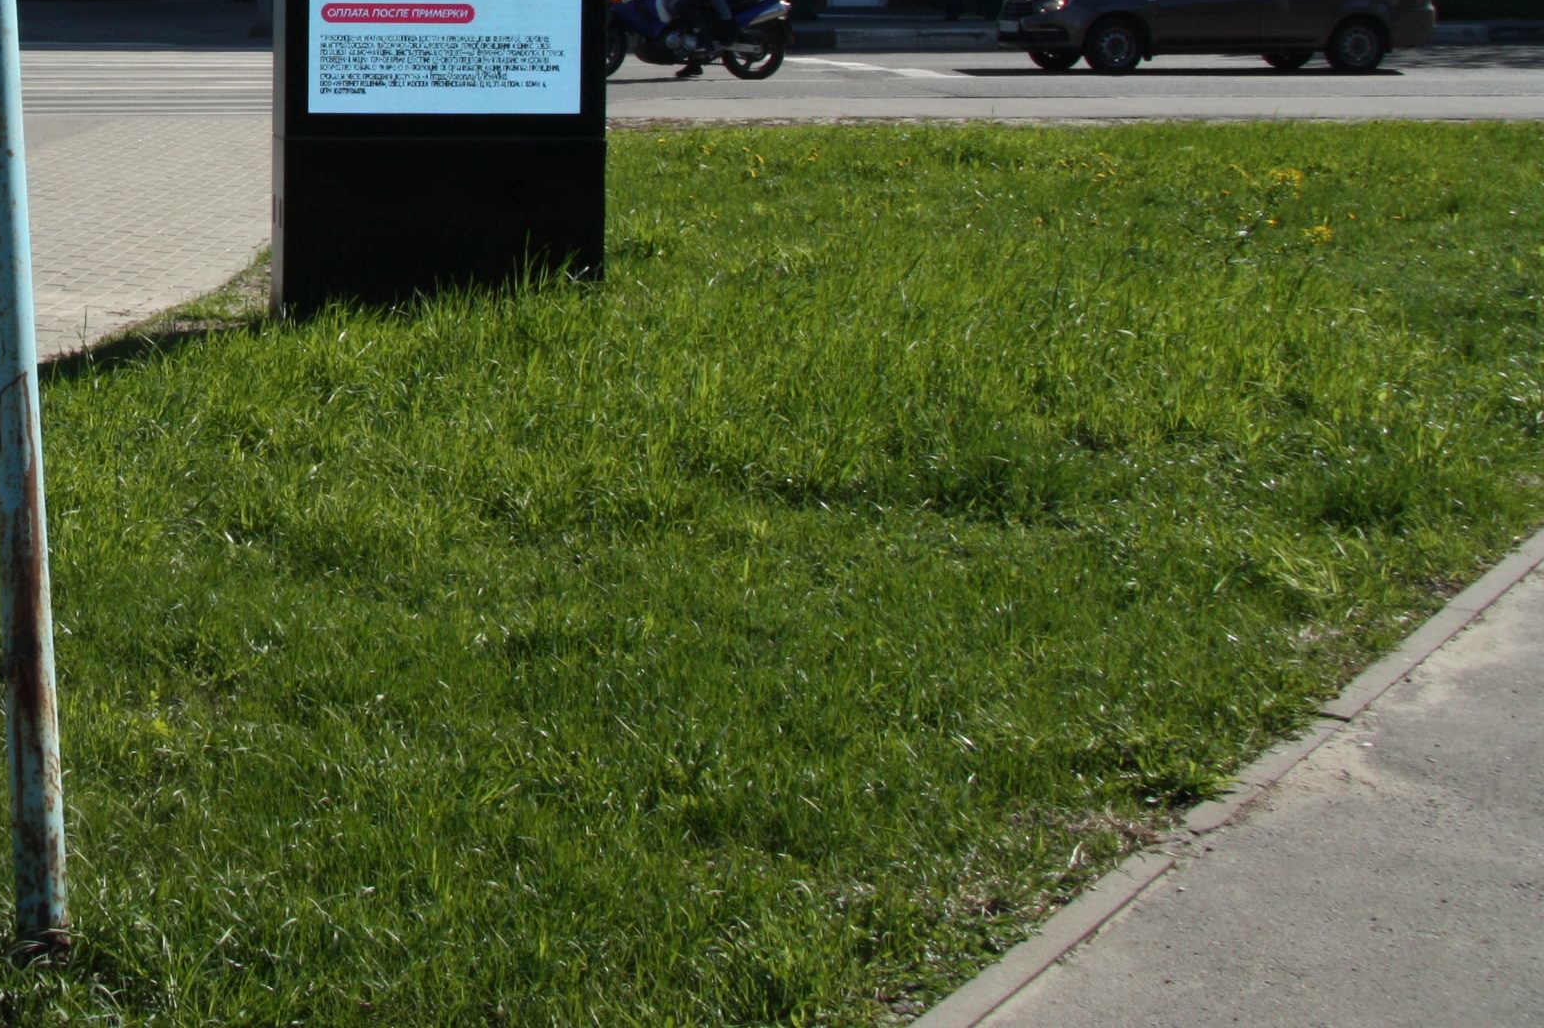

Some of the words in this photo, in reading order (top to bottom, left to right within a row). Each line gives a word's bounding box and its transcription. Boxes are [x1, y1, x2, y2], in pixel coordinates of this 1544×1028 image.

[327, 8, 369, 18] ОПЛАТА
[371, 8, 409, 18] ПОСЛЕ
[411, 8, 469, 19] ПРИМЕРКИ
